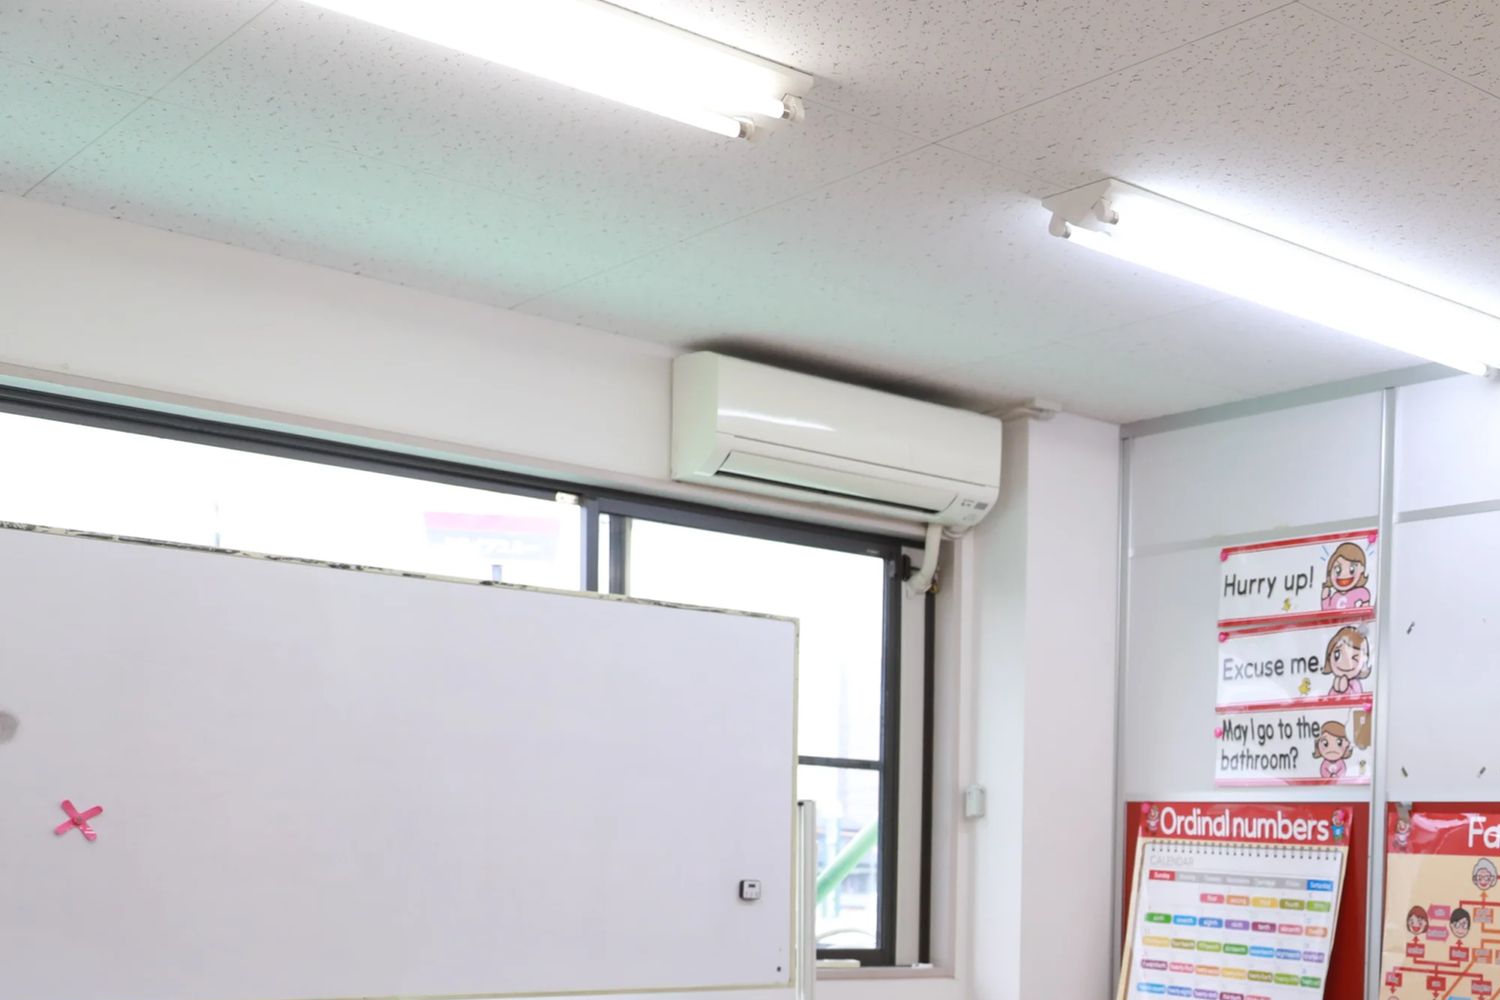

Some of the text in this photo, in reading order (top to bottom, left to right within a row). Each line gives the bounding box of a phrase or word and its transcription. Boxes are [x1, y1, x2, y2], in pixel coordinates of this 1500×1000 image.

[1224, 566, 1314, 598] Hurry up!
[1223, 655, 1324, 681] Excuse me.
[1222, 716, 1320, 746] May I go to the
[1220, 747, 1298, 771] bathroom?
[1160, 807, 1329, 841] Ordinal numbers
